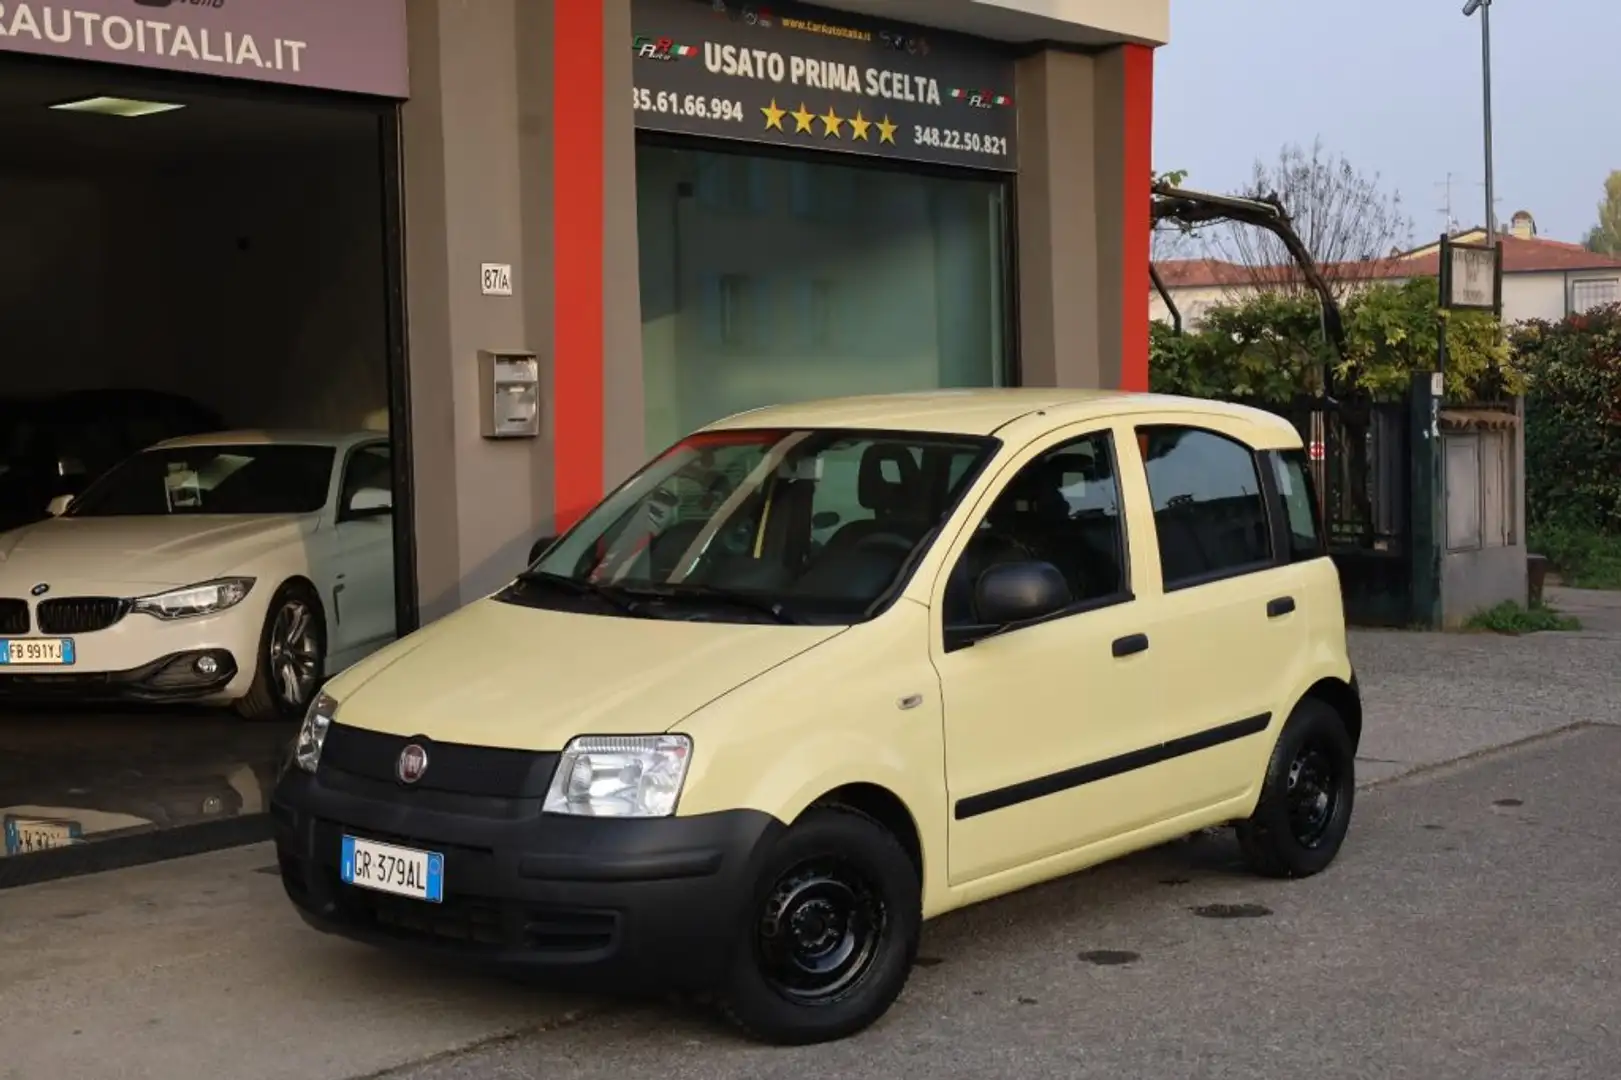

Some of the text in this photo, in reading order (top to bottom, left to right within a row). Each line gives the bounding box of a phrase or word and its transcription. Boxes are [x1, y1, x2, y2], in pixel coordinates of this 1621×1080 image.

[0, 3, 307, 72] AUTOITALIA.IT
[704, 41, 941, 106] USATO PRIMA SCELTA
[913, 125, 1007, 155] 348.22.50.821
[484, 268, 509, 290] 87/A
[10, 644, 23, 659] FB
[27, 644, 61, 659] 991YJ
[355, 849, 372, 879] GR
[377, 853, 425, 890] 379AL
